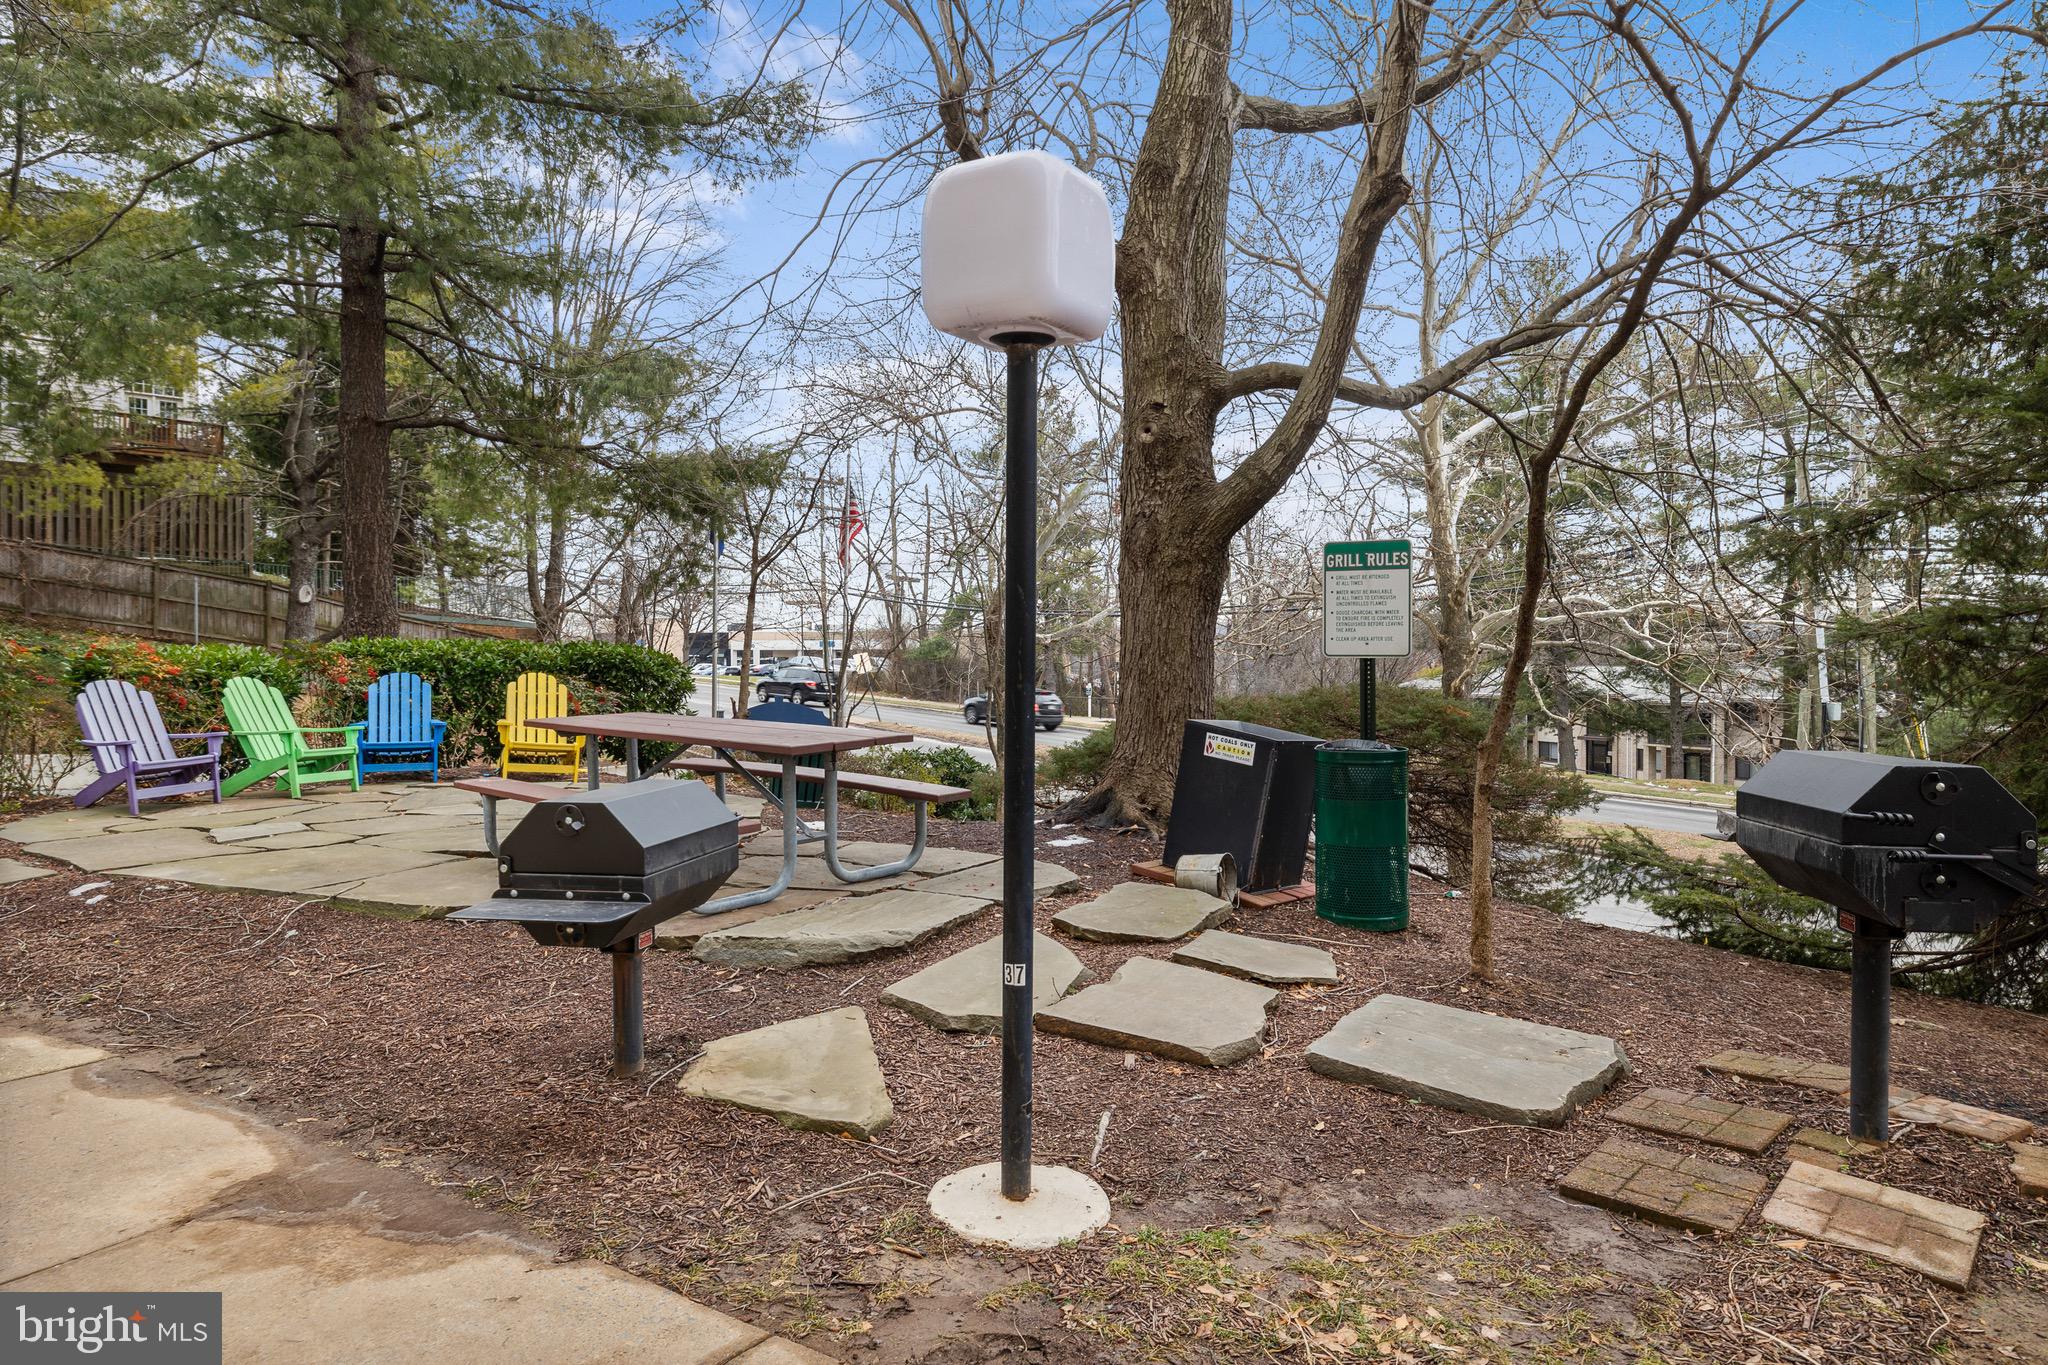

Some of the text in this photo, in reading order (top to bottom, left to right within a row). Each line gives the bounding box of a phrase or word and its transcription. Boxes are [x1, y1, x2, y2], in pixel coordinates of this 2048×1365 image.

[1326, 552, 1408, 568] GRILL RULES
[1220, 737, 1238, 746] COALS
[1217, 744, 1250, 756] CAUTION
[1006, 966, 1024, 984] 37
